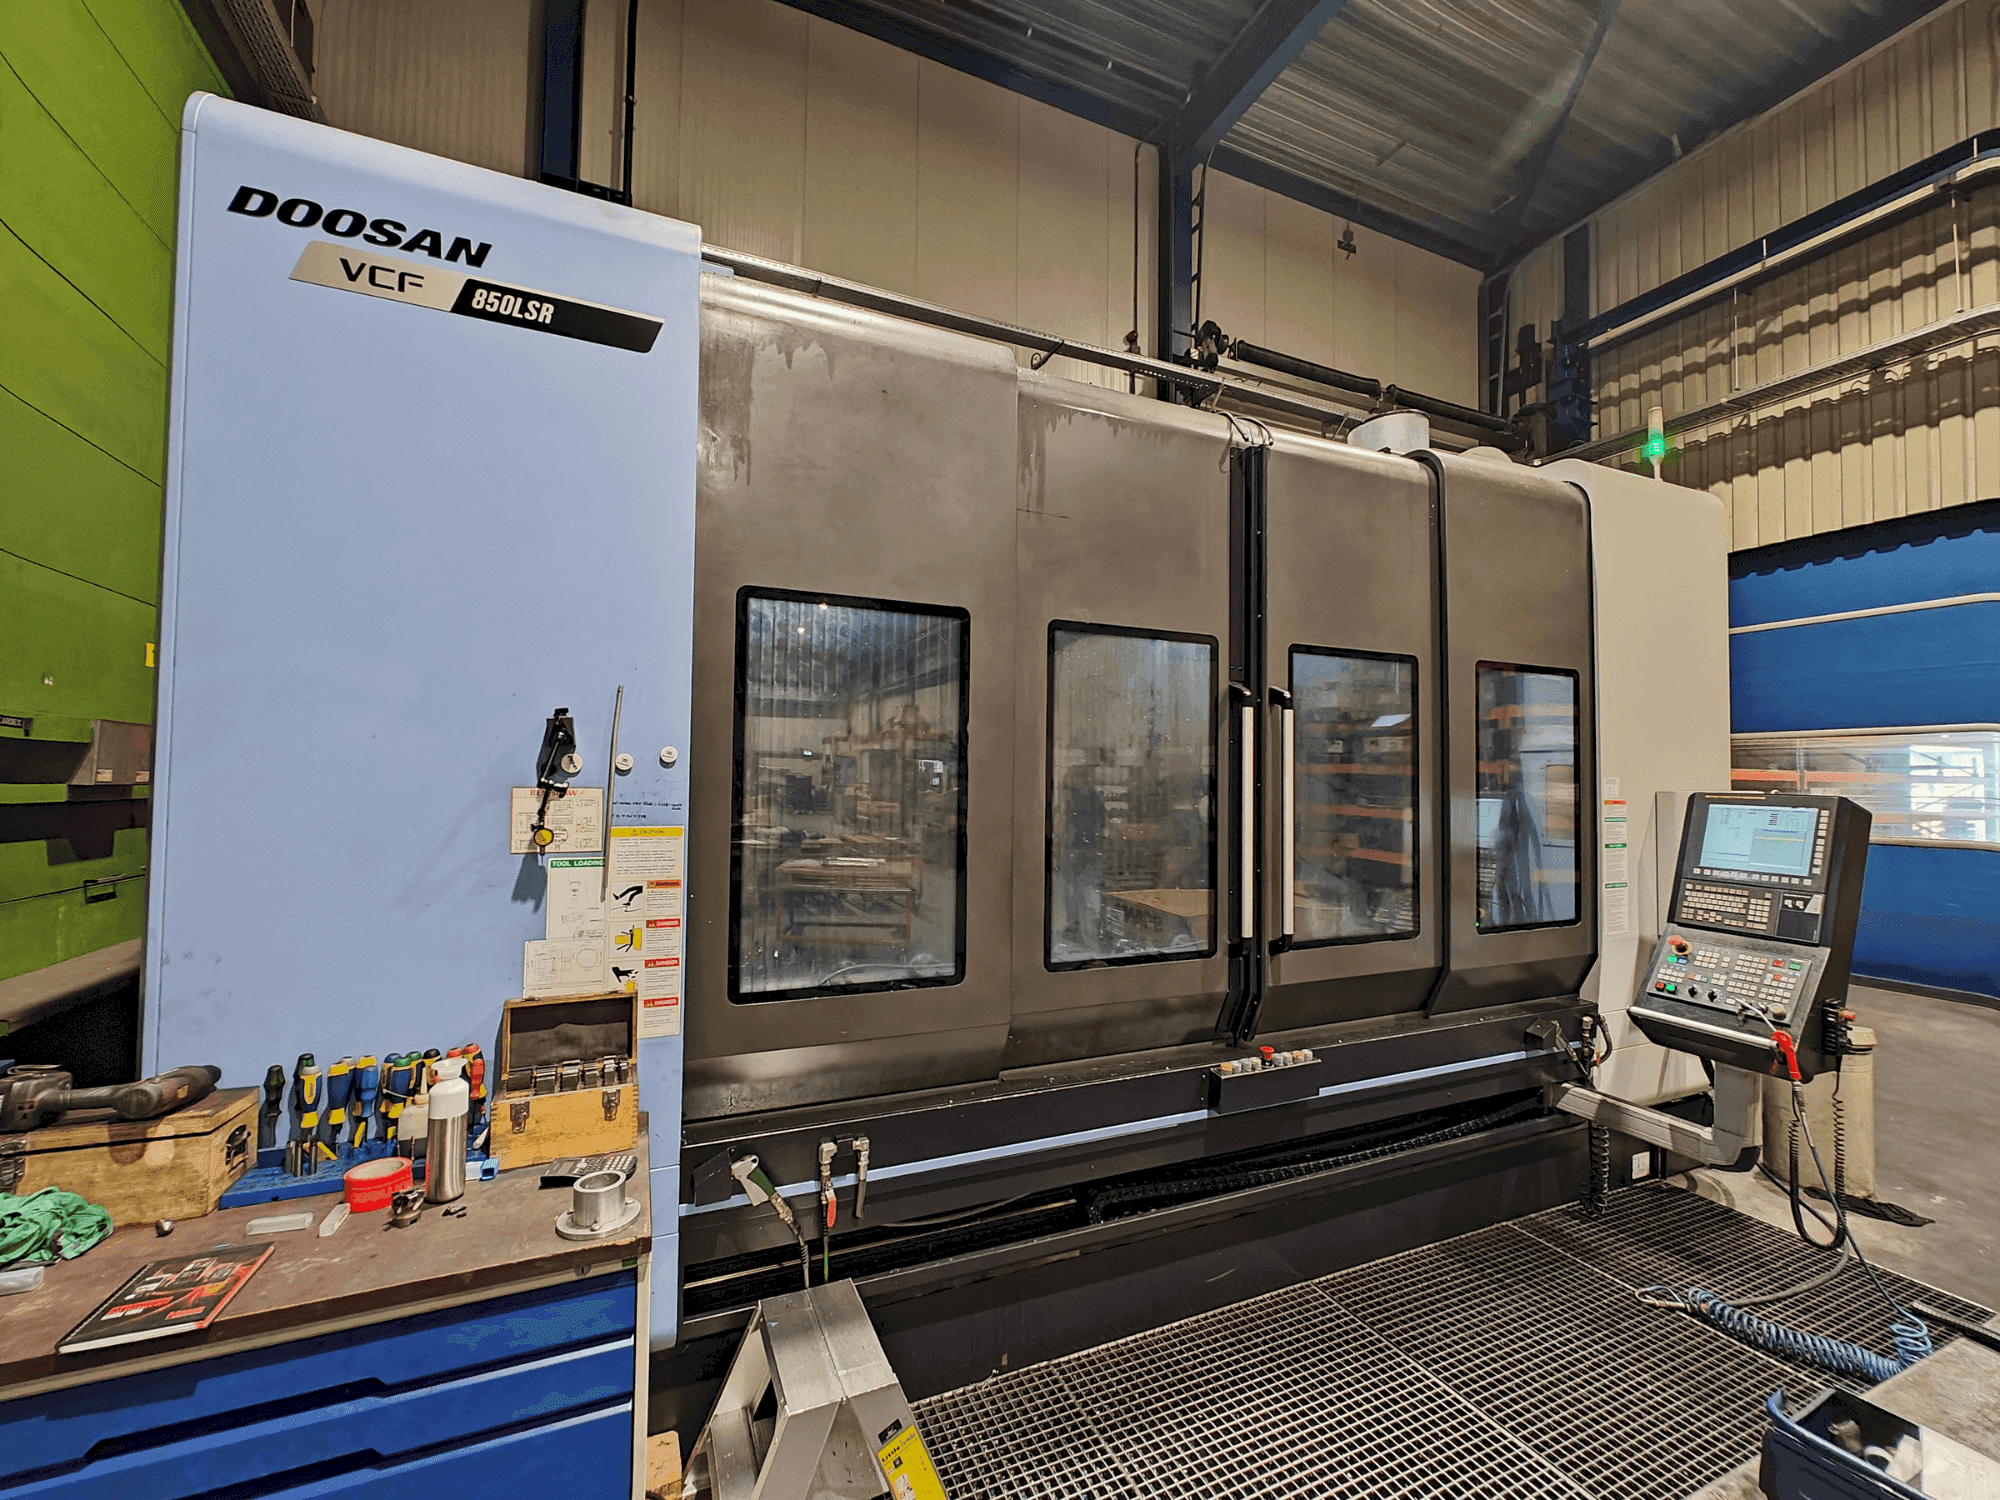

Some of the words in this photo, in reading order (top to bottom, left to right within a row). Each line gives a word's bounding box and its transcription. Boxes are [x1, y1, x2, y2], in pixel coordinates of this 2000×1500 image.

[226, 185, 492, 268] DOOSAN
[339, 258, 424, 292] VCF
[471, 288, 555, 324] 850LSR
